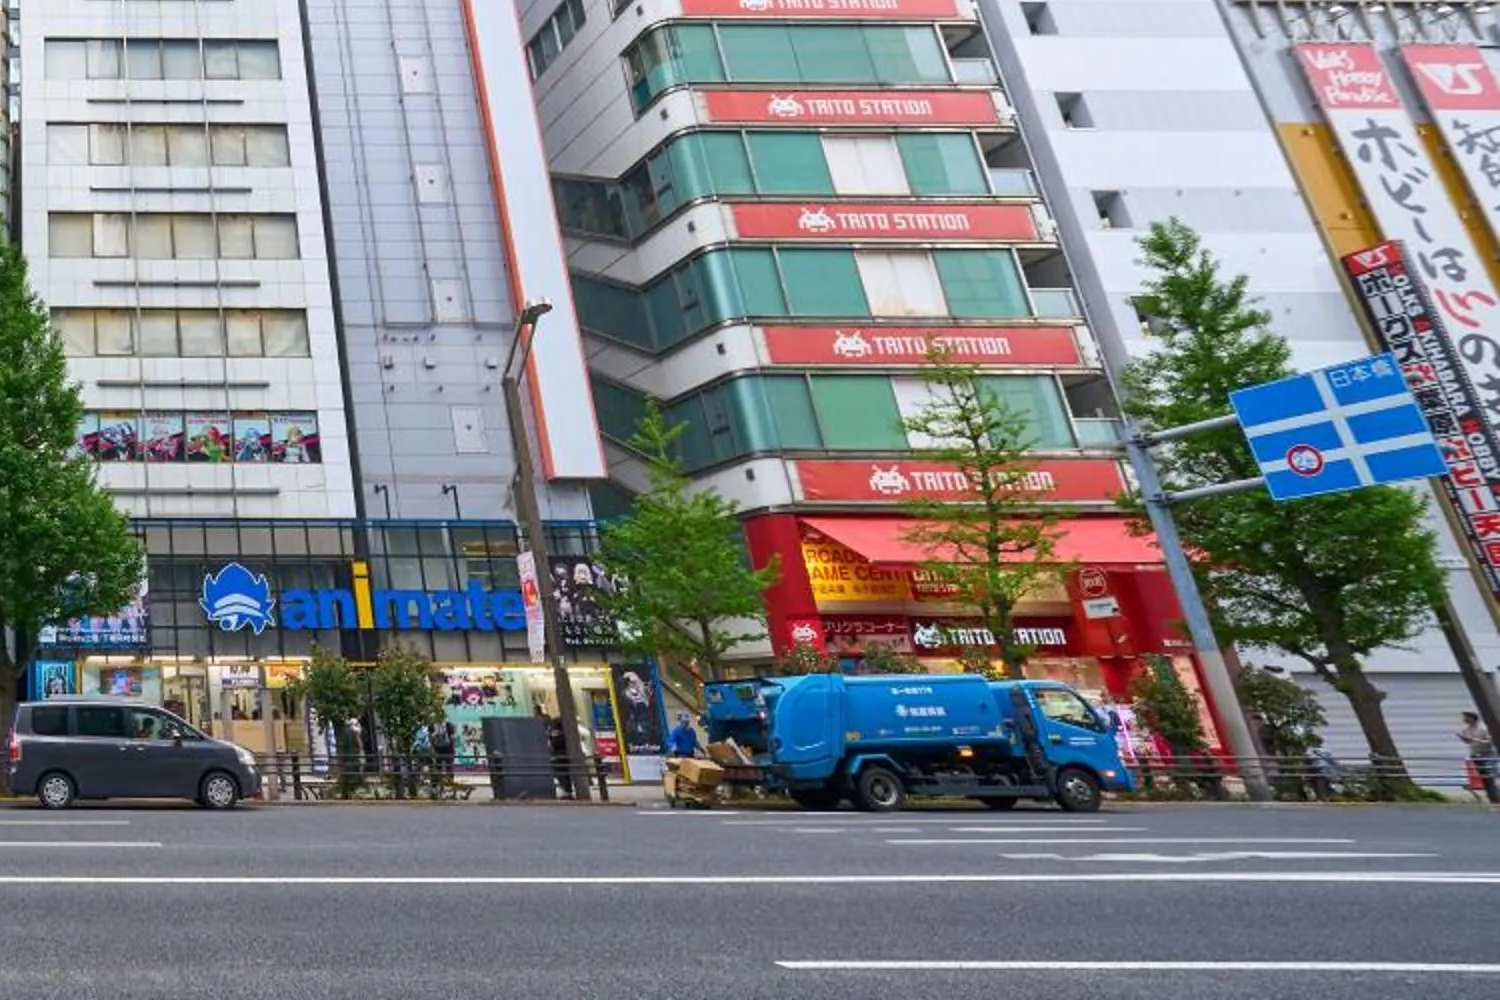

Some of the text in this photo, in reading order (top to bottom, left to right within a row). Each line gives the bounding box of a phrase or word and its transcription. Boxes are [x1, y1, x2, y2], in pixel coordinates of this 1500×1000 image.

[804, 99, 933, 116] TAITO STATION
[836, 213, 970, 231] TAITO STATION
[872, 336, 926, 354] TAITO
[910, 471, 966, 490] TAITO
[811, 566, 850, 580] AME
[281, 560, 526, 631] animate
[947, 627, 1067, 645] TAITO ATION
